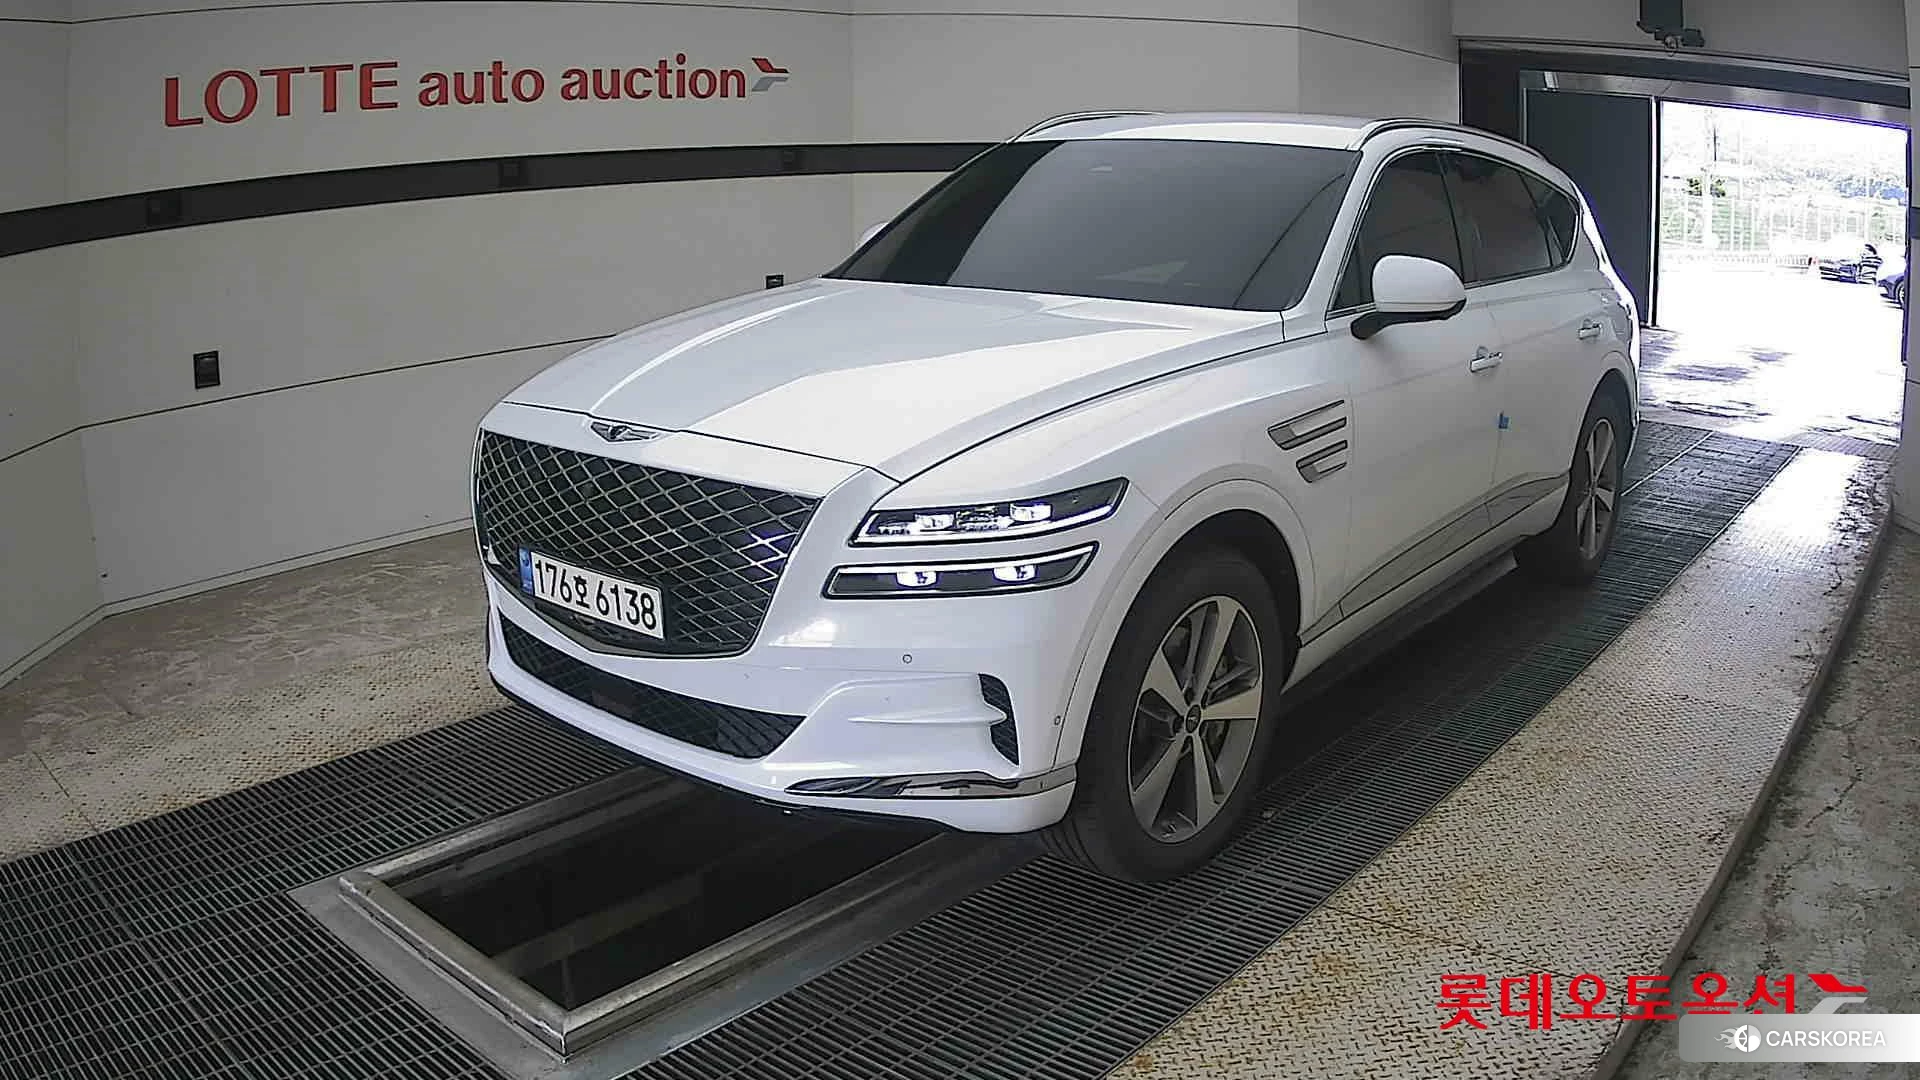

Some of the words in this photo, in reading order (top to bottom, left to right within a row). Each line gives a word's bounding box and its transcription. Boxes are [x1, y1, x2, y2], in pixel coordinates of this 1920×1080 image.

[164, 61, 399, 127] LOTTE
[418, 60, 546, 107] auto
[560, 53, 746, 99] auction
[535, 559, 591, 609] 176호
[596, 580, 657, 630] 6138
